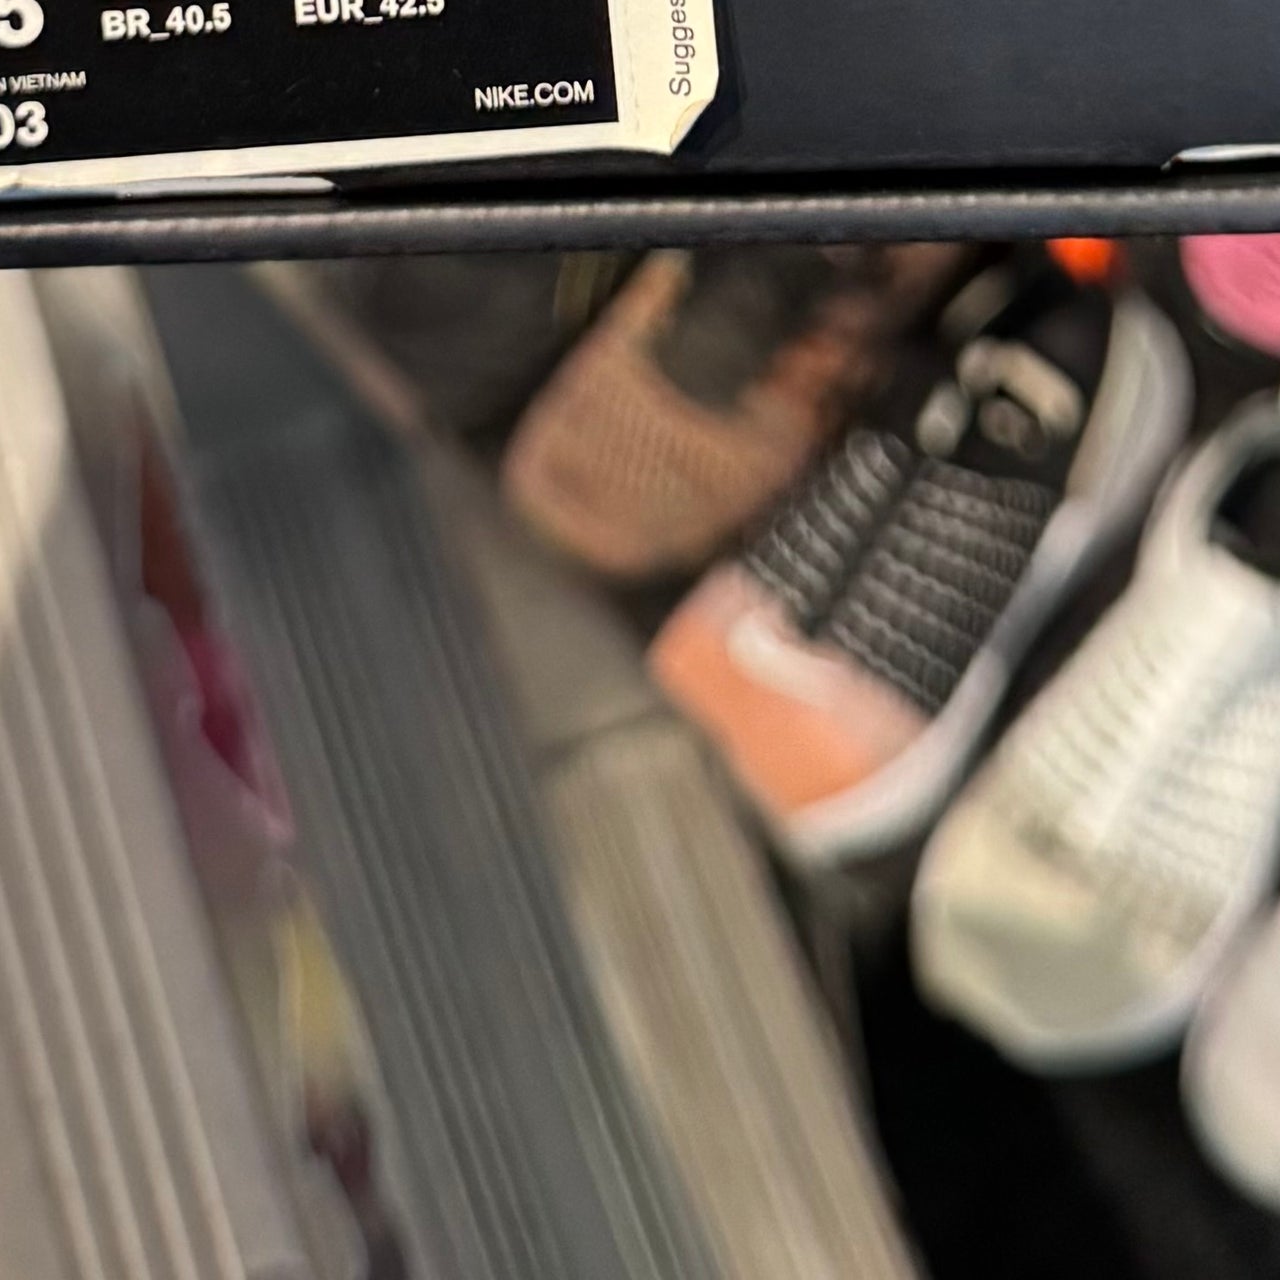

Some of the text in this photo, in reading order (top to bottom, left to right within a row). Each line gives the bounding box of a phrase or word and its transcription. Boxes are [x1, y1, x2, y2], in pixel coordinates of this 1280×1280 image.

[101, 2, 232, 41] BR_40.5
[10, 71, 87, 95] VIETNAM
[475, 79, 594, 112] NIKE.COM
